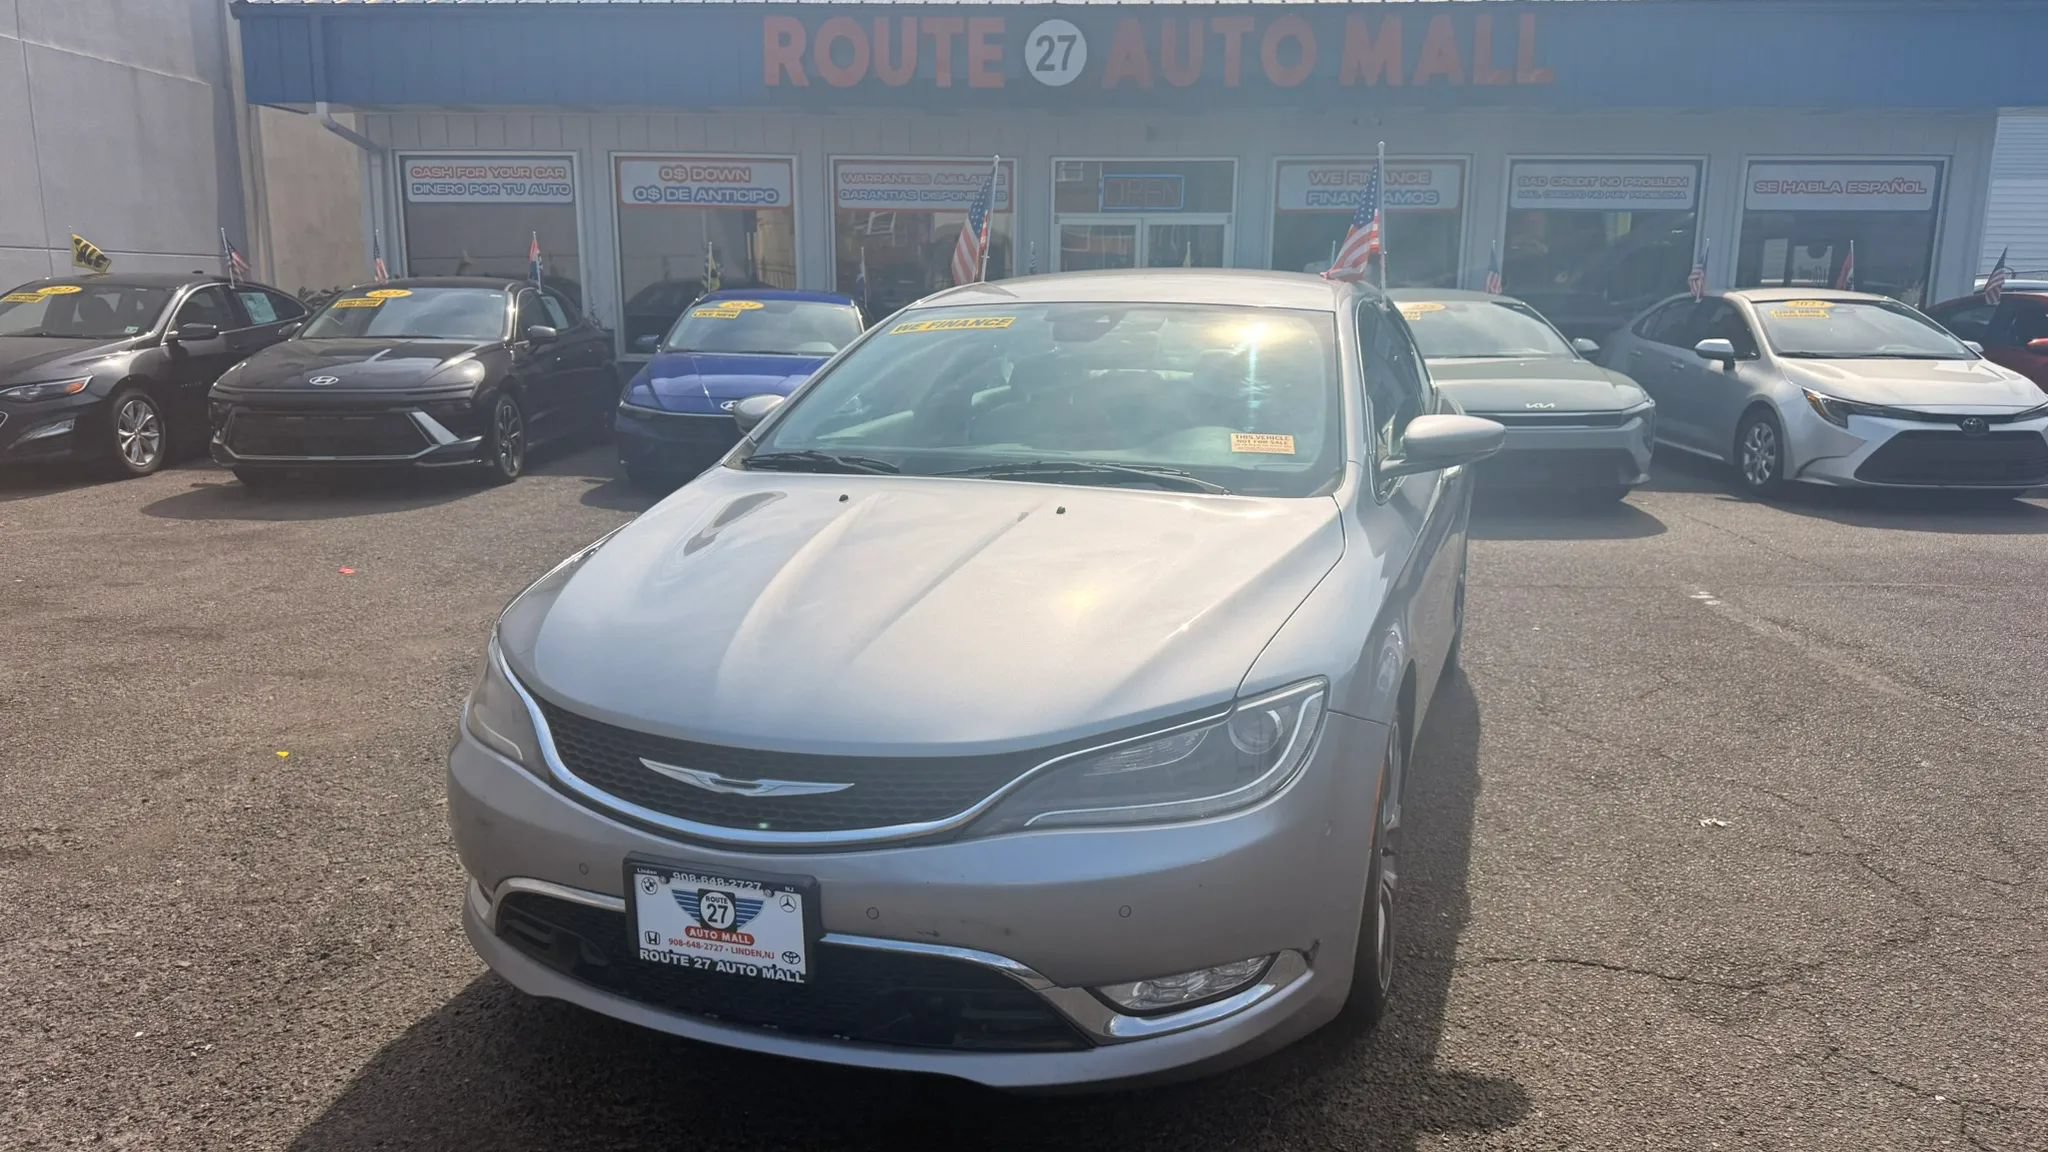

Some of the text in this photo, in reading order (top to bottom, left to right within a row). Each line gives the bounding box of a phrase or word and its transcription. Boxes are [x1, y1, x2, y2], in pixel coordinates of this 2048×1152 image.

[763, 13, 1555, 89] ROUTE 27 AUTO MALL
[411, 166, 567, 179] CASH FOR YOUR CAR
[690, 166, 752, 182] DOWN
[1309, 170, 1345, 185] WE
[412, 183, 571, 196] DINERO POR TU AUTO
[1518, 176, 1548, 187] BAD
[1550, 176, 1598, 188] CREDIT
[1599, 176, 1622, 188] NO
[1755, 178, 1927, 195] SE HABLA ESPAÑOL
[663, 186, 692, 203] DE
[694, 187, 780, 204] ANTICIPO
[894, 318, 1012, 333] WE FINANCE
[672, 871, 763, 890] 908-648-2727
[705, 895, 729, 905] ROUTE
[706, 903, 729, 924] 27
[689, 928, 751, 944] AUTO MALL
[668, 937, 724, 953] 908-648-2727
[640, 949, 804, 983] ROUTE 27 AUTO MALL
